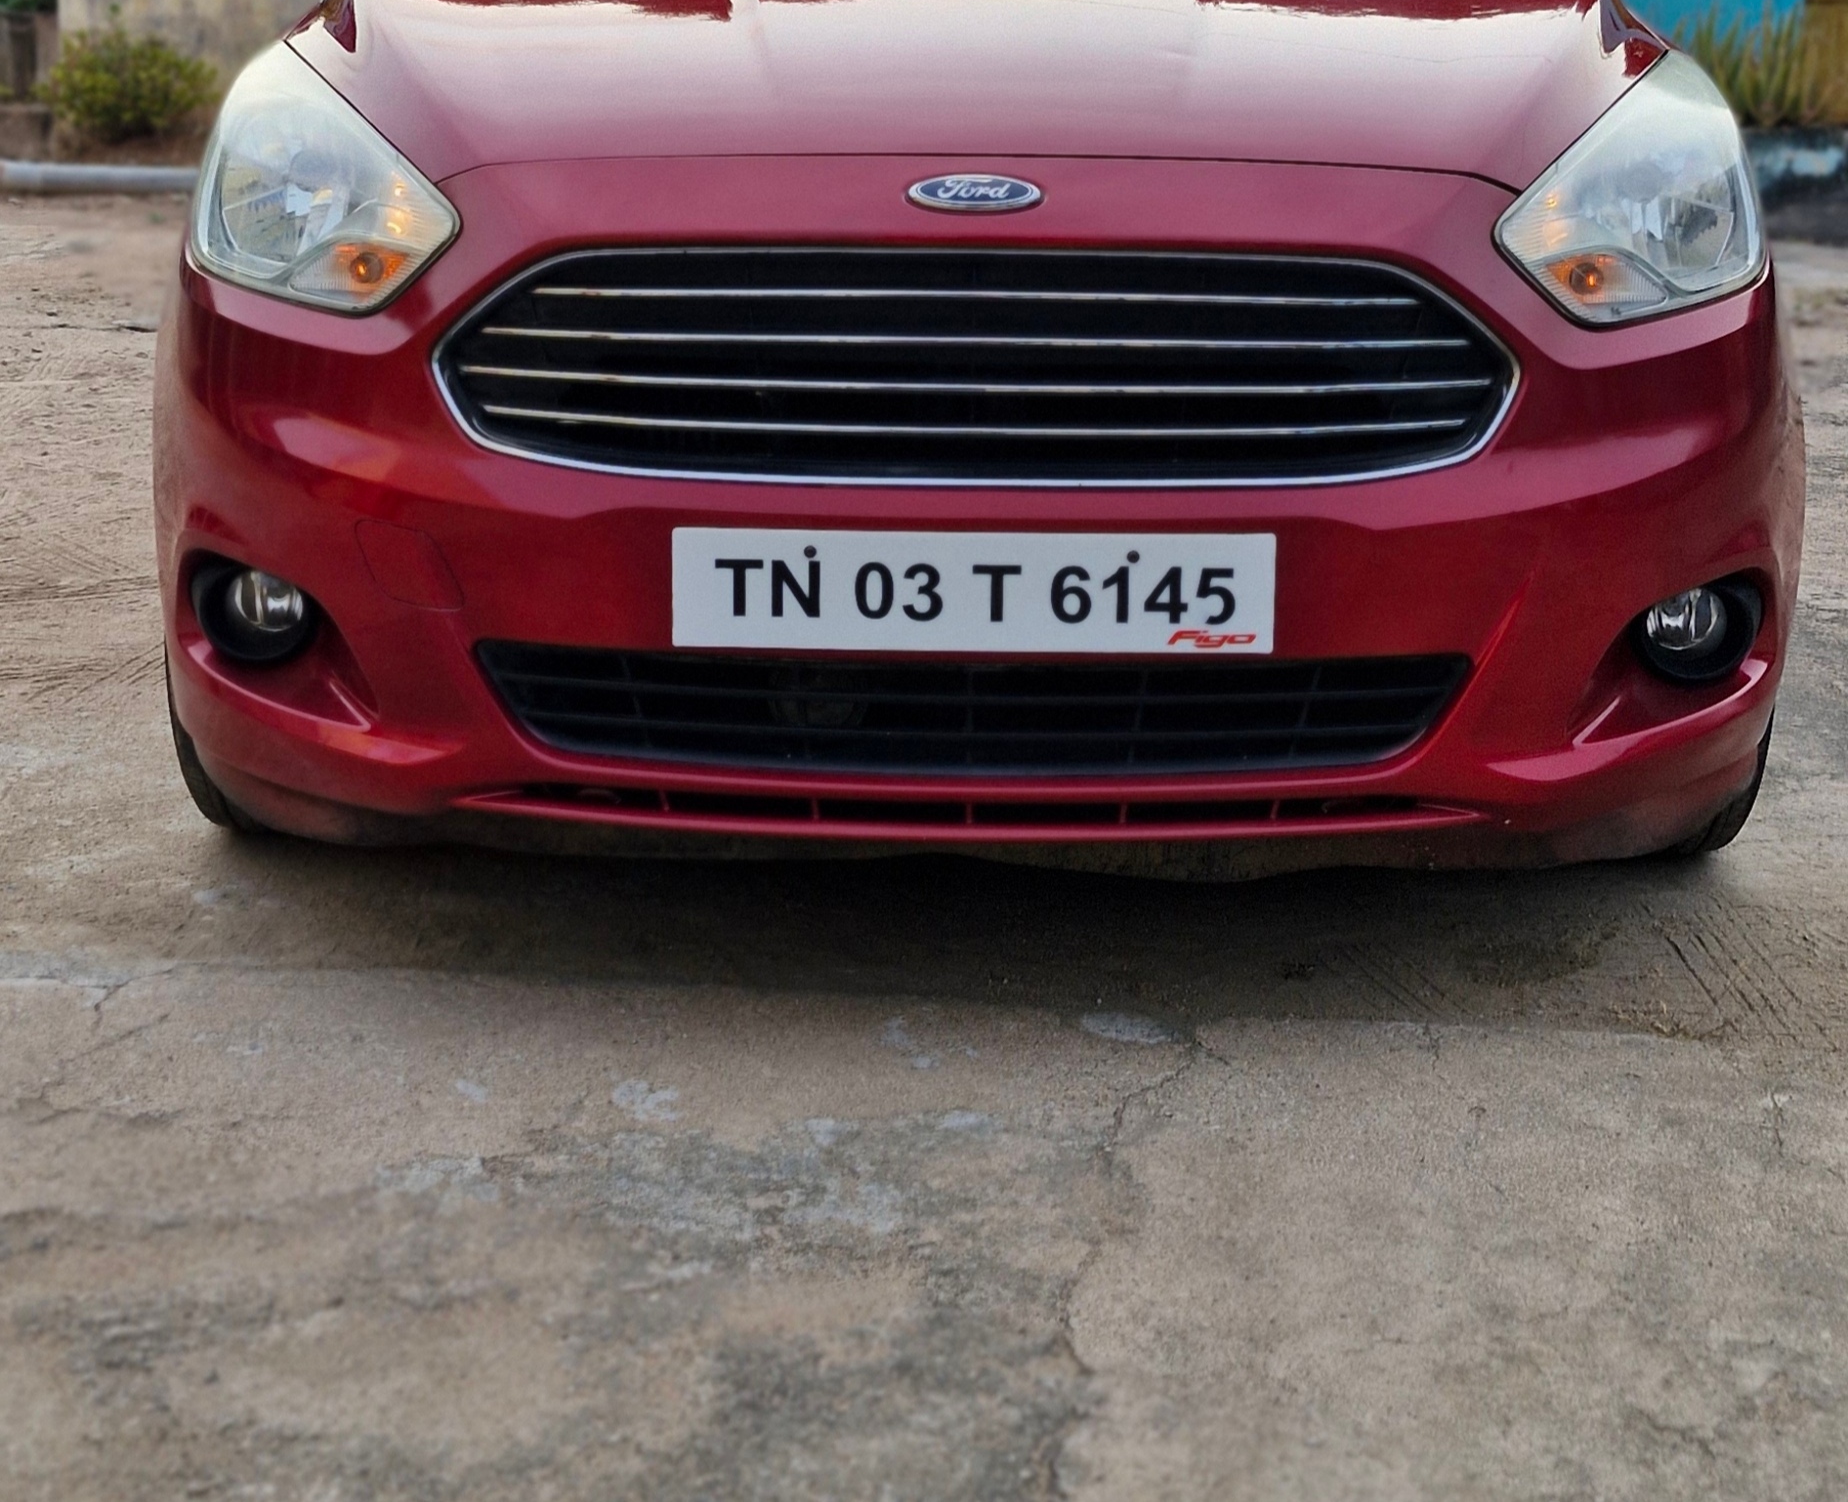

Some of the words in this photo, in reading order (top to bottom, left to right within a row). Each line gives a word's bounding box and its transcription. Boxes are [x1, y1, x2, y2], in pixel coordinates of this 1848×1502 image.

[937, 178, 1011, 199] Ford
[714, 558, 821, 618] TN
[854, 561, 944, 622] 03
[972, 564, 1023, 623] T
[1050, 565, 1236, 626] 6145
[1167, 630, 1257, 649] Figo
